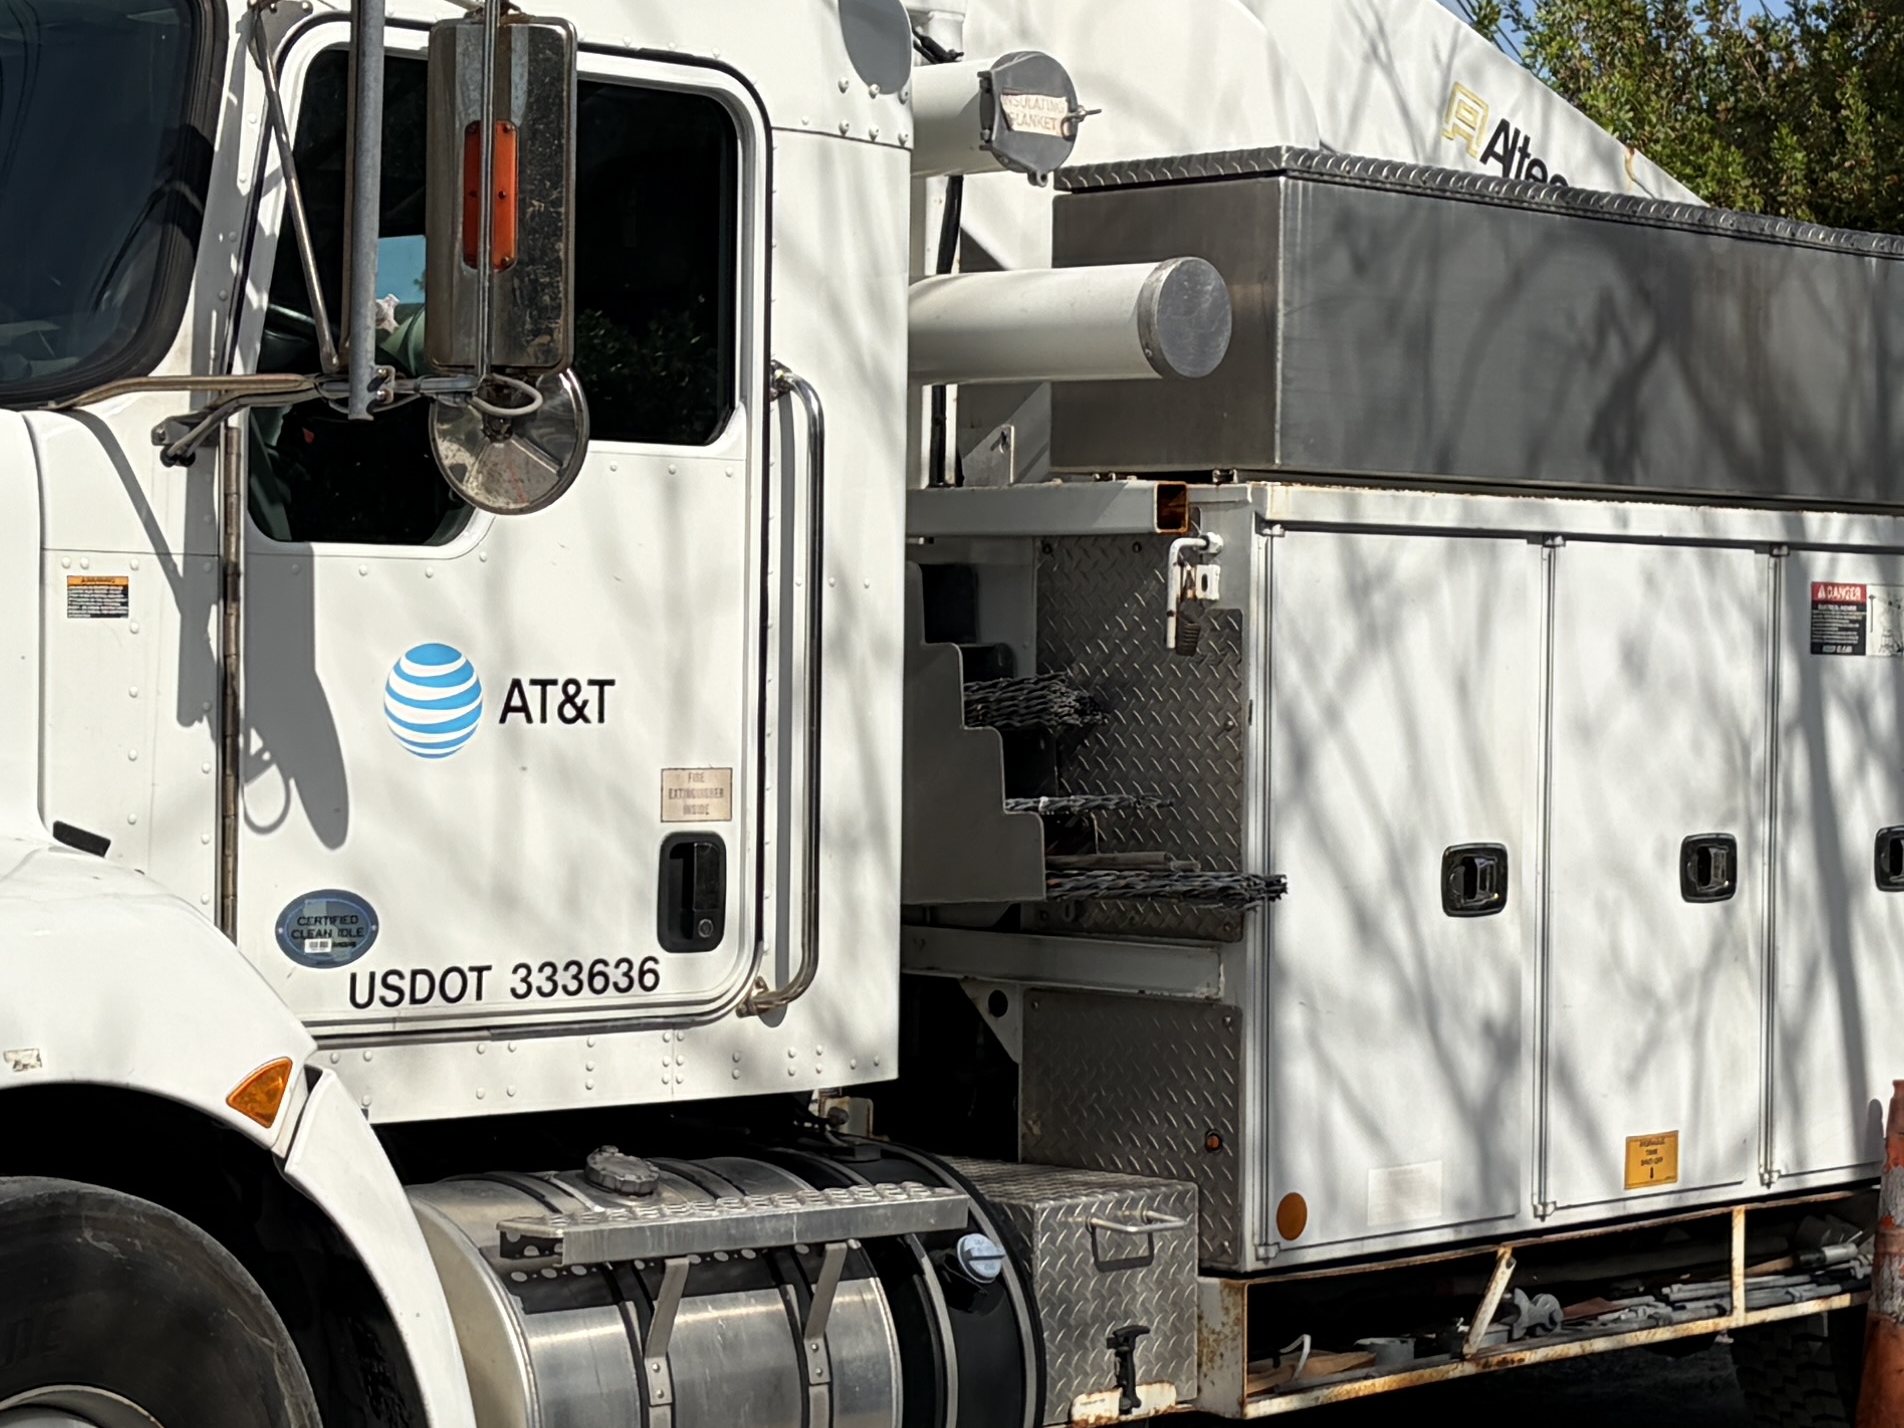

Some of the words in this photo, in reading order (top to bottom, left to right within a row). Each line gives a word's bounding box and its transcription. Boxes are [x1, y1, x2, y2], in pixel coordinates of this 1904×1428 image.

[499, 677, 616, 725] AT&T
[290, 928, 333, 940] CLEAN
[338, 926, 365, 938] IDLE
[297, 915, 359, 926] CERTIFIED
[348, 964, 492, 1009] USDOT
[510, 956, 661, 1001] 333636
